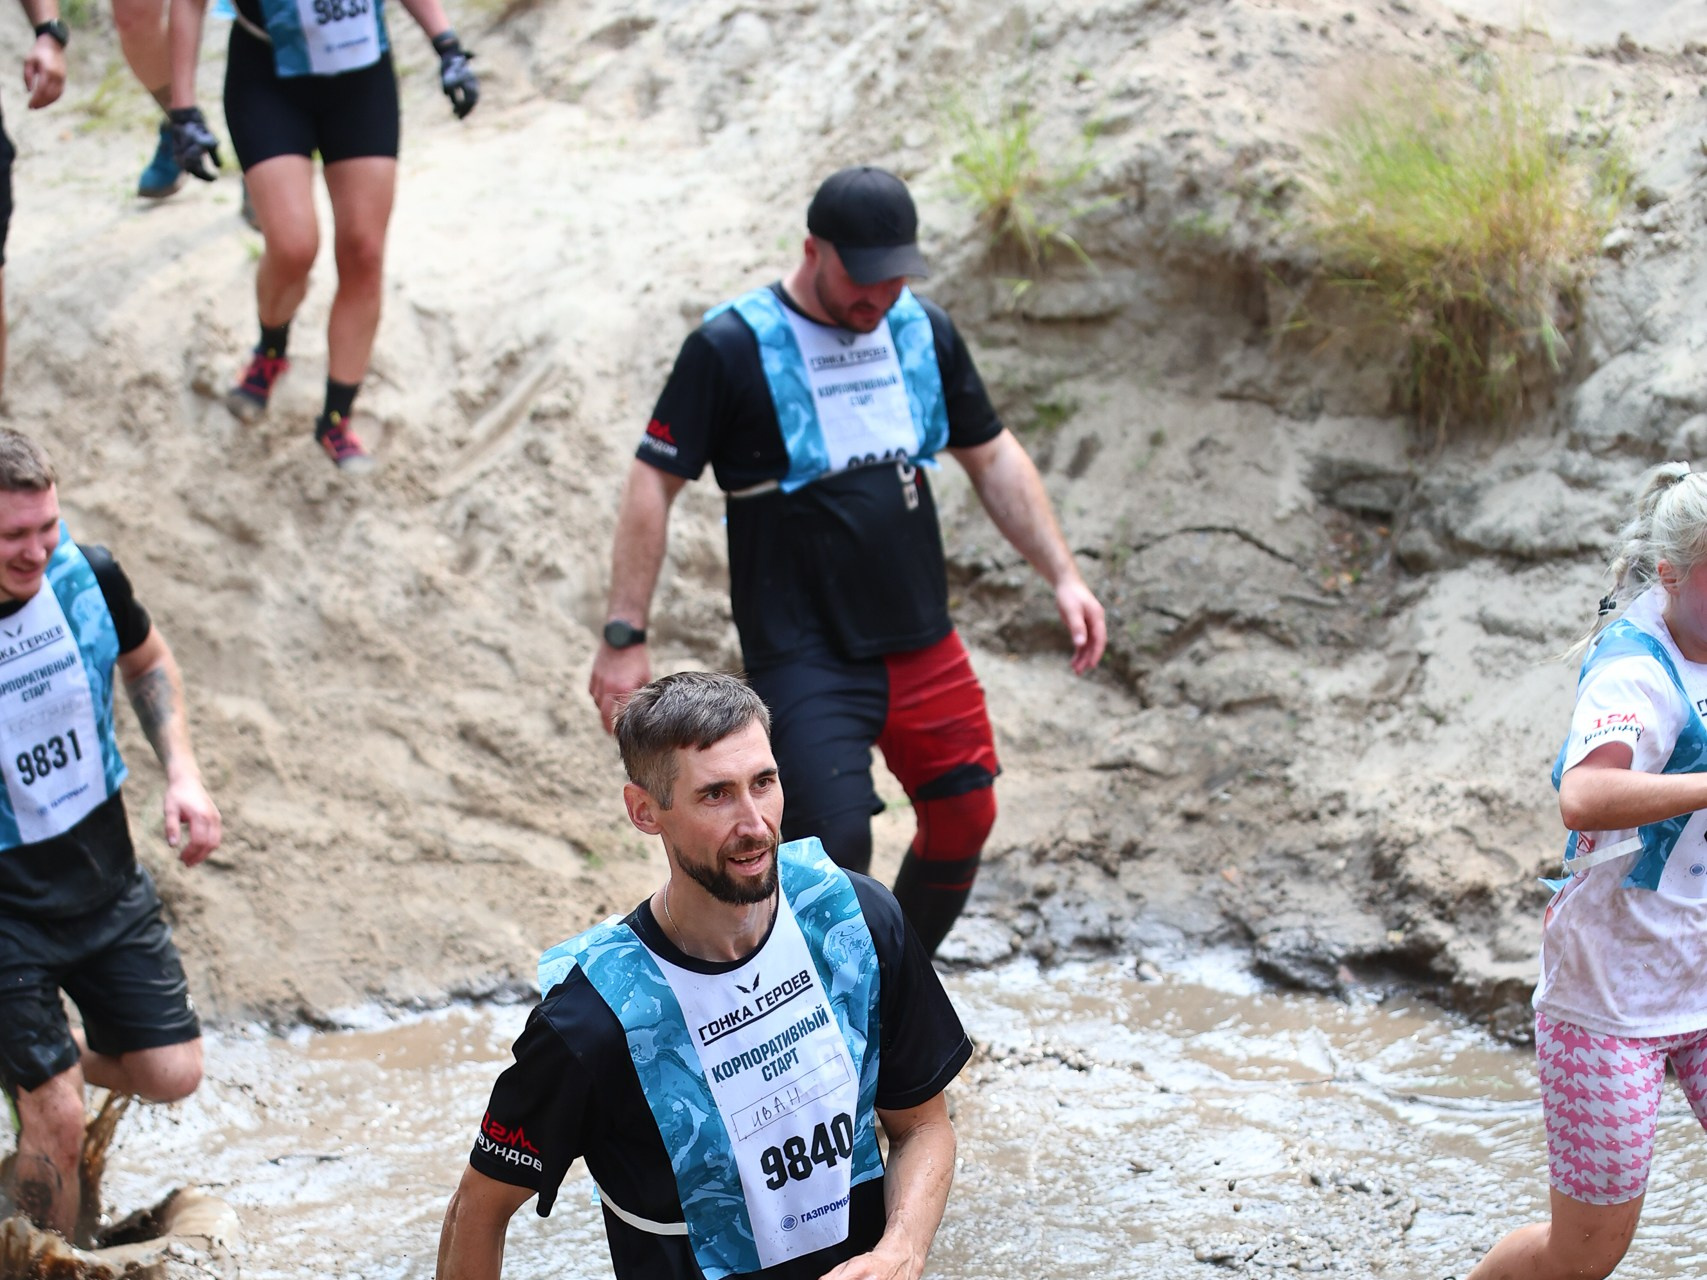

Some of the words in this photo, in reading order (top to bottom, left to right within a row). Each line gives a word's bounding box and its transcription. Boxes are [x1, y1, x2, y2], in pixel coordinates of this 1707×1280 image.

[0, 650, 77, 698] РПОРАТИВНЫЙ
[21, 680, 52, 703] СТАРТ
[16, 728, 82, 787] 9831
[698, 1005, 754, 1041] ГОНКА
[755, 969, 811, 1012] ГЕРОЕВ
[712, 1003, 830, 1084] КОРПОРАТИВНЫЙ
[761, 1047, 800, 1082] СТАРТ
[751, 1086, 801, 1128] ИВАН
[478, 1132, 543, 1172] аундов
[760, 1112, 854, 1191] 9840
